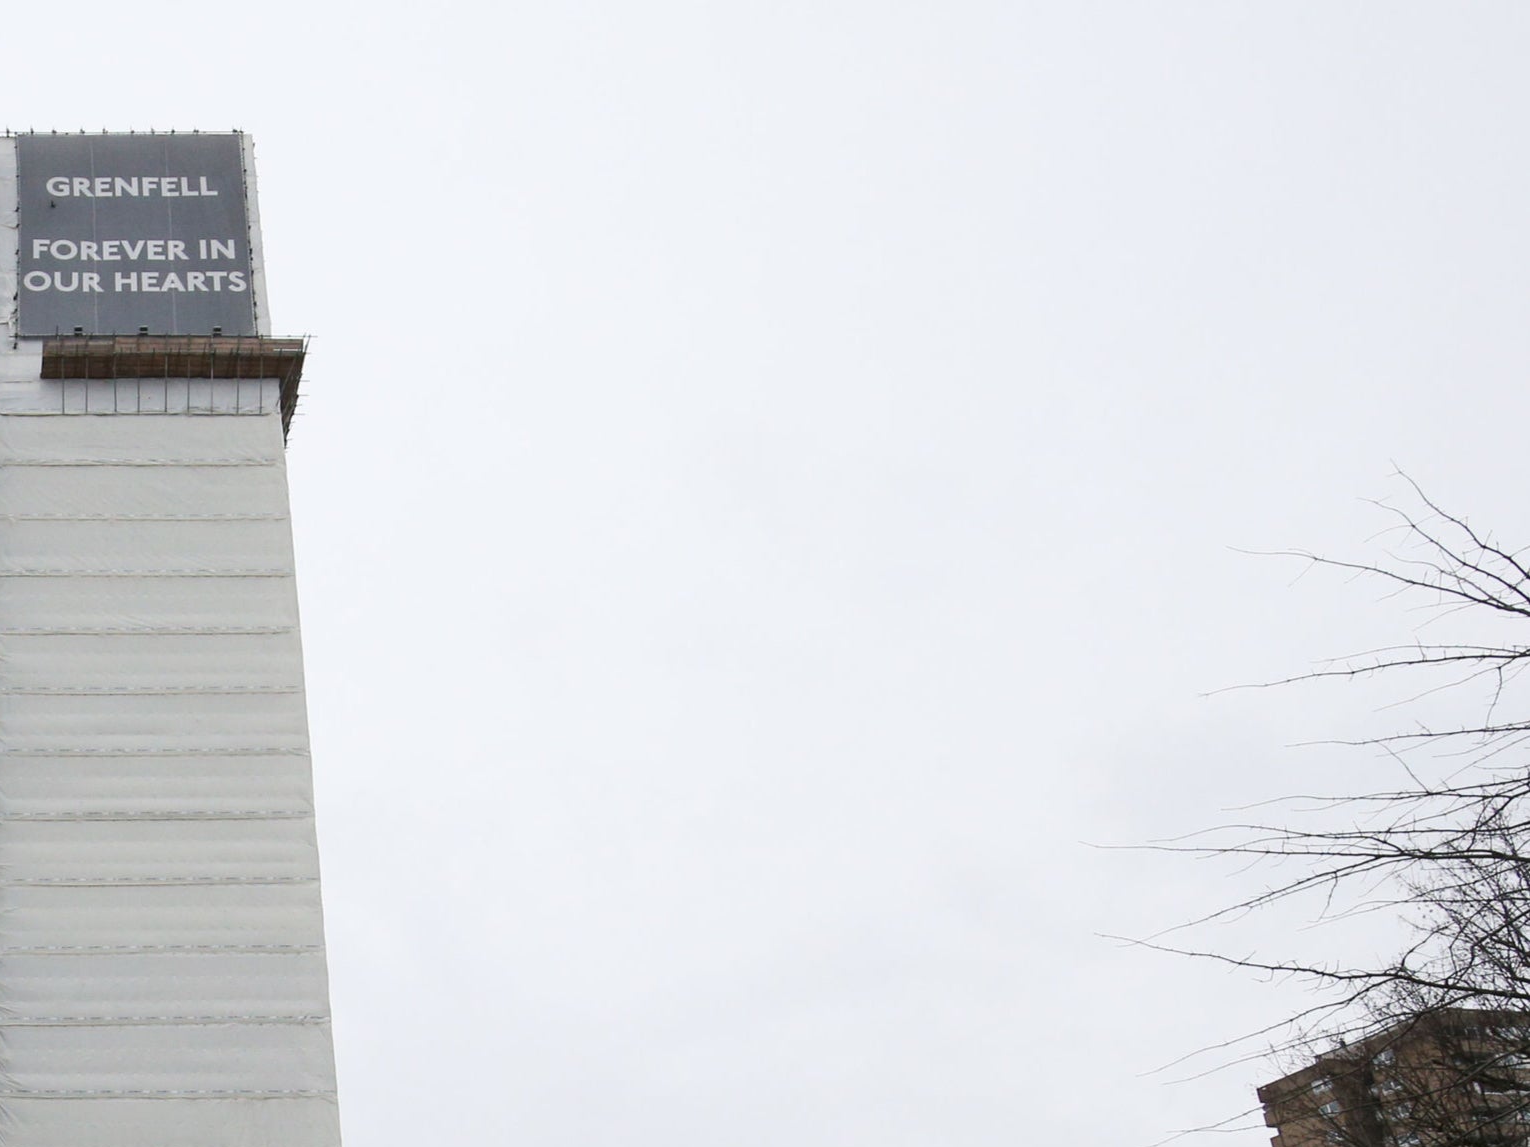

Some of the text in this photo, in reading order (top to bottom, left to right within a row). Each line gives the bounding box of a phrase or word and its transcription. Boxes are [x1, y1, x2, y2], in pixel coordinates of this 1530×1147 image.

[45, 176, 219, 198] GRENFELL
[32, 238, 236, 262] FOREVER IN
[23, 270, 247, 293] OUR HEARTS
